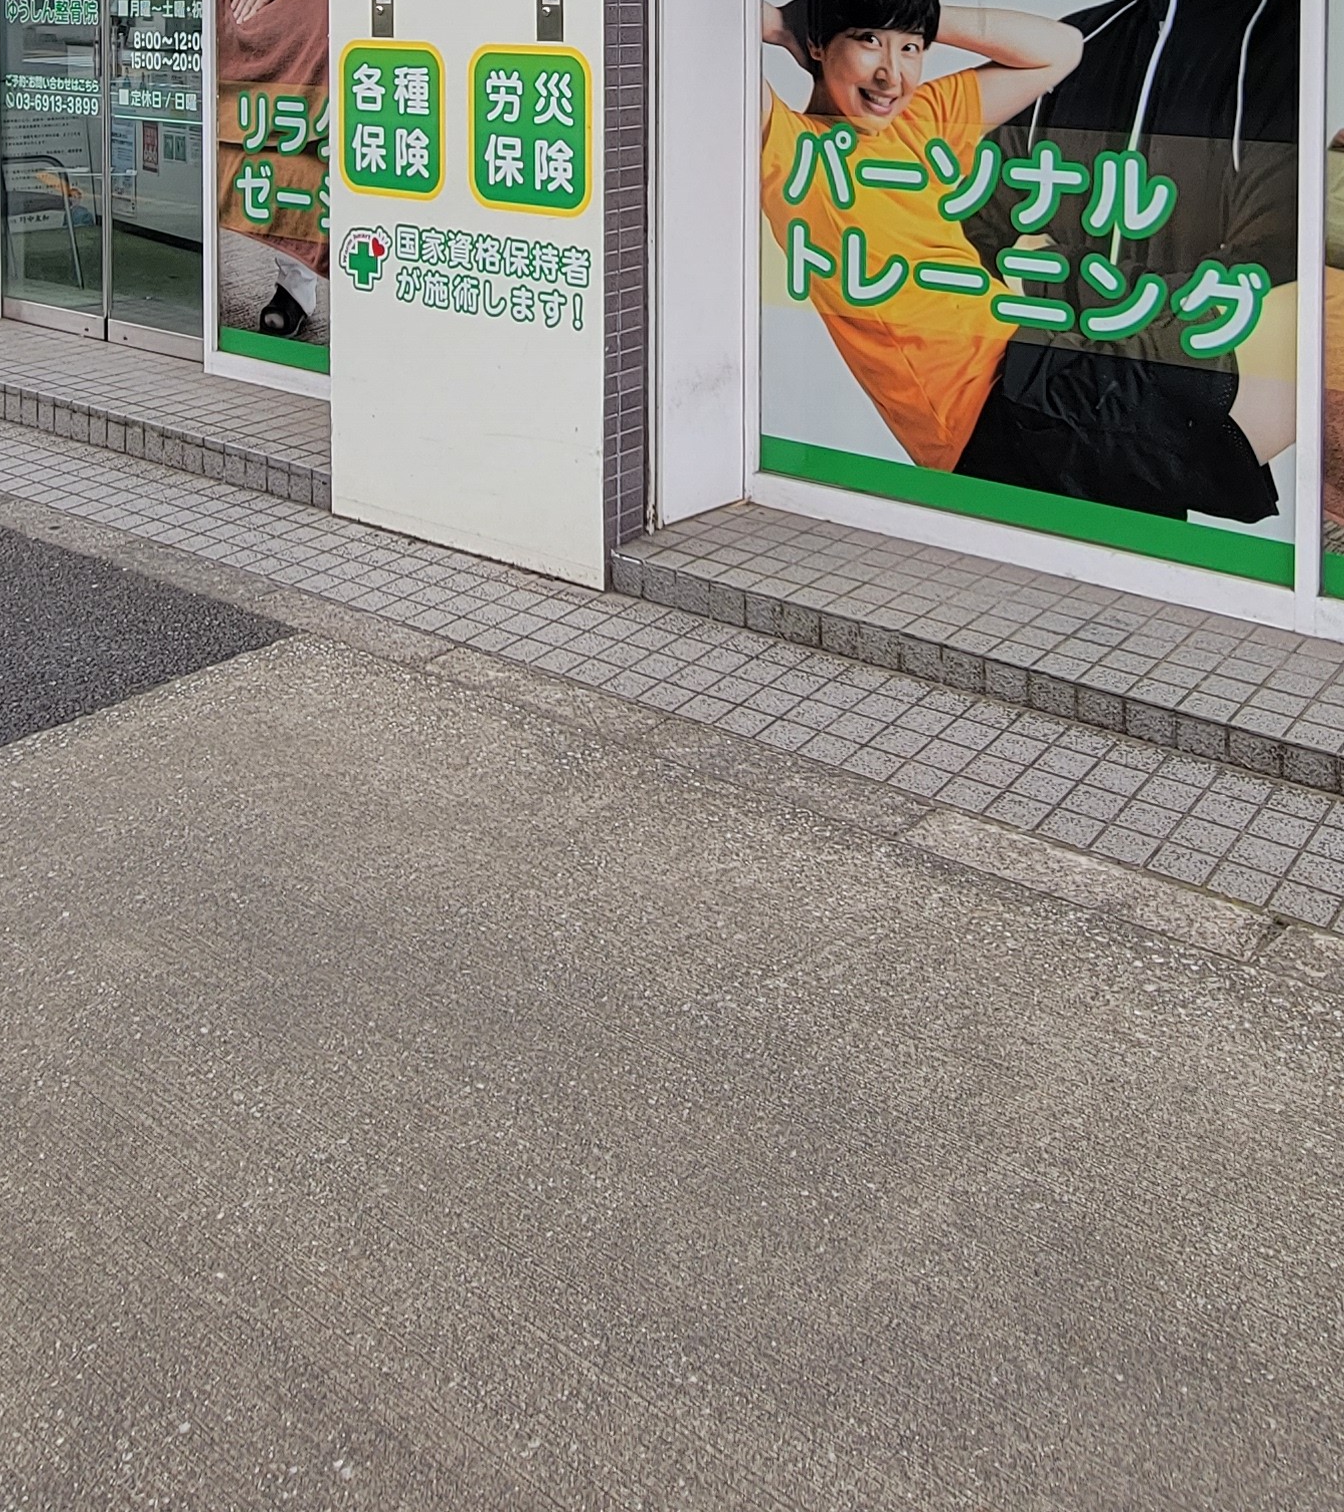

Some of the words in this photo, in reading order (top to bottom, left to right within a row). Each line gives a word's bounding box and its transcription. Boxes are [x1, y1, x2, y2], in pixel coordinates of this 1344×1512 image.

[130, 52, 202, 71] 15:00～20:0
[134, 31, 202, 50] 8:00～12:0
[16, 92, 99, 116] 03-6913-3899
[130, 90, 161, 108] 定休日
[352, 64, 431, 117] 各種
[485, 69, 574, 129] 労災
[352, 123, 431, 180] 保険
[484, 132, 575, 195] 保険
[787, 128, 1172, 235] パーソナル
[395, 224, 591, 288] 国家資格保持者
[790, 221, 1266, 353] トレーニング
